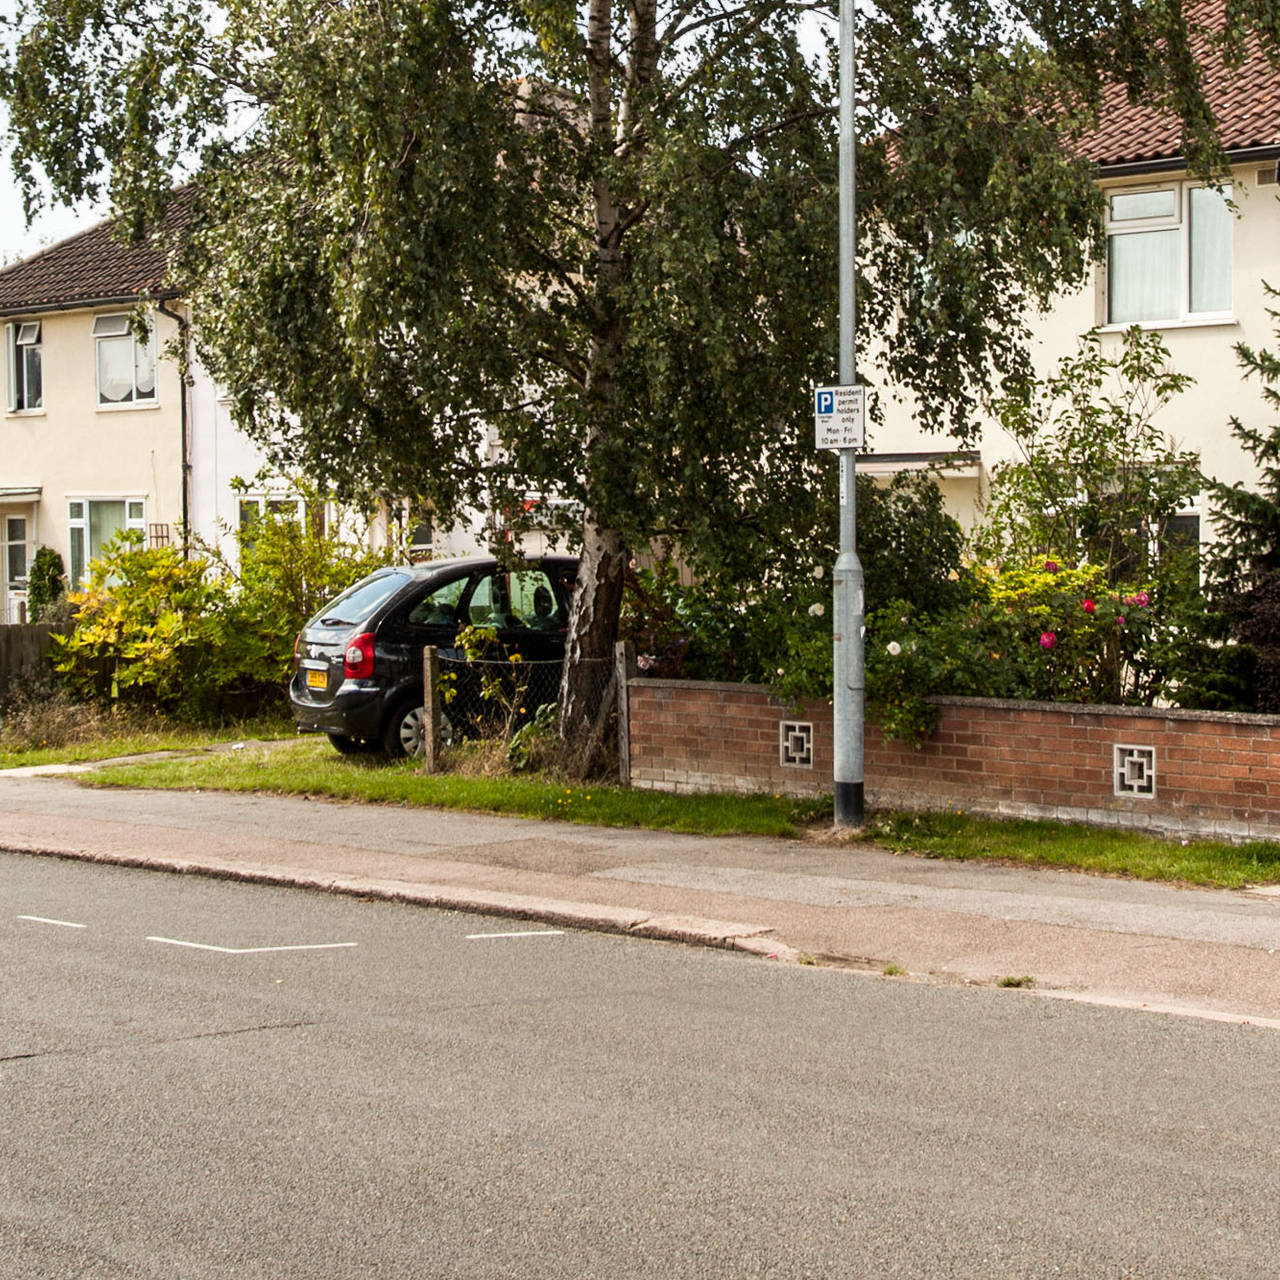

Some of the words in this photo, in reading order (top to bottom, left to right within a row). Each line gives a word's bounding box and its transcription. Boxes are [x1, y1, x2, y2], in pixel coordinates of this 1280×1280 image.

[835, 388, 862, 396] Resident
[821, 394, 831, 412] P
[838, 398, 858, 406] permit
[841, 415, 854, 423] only
[826, 426, 839, 434] Mon
